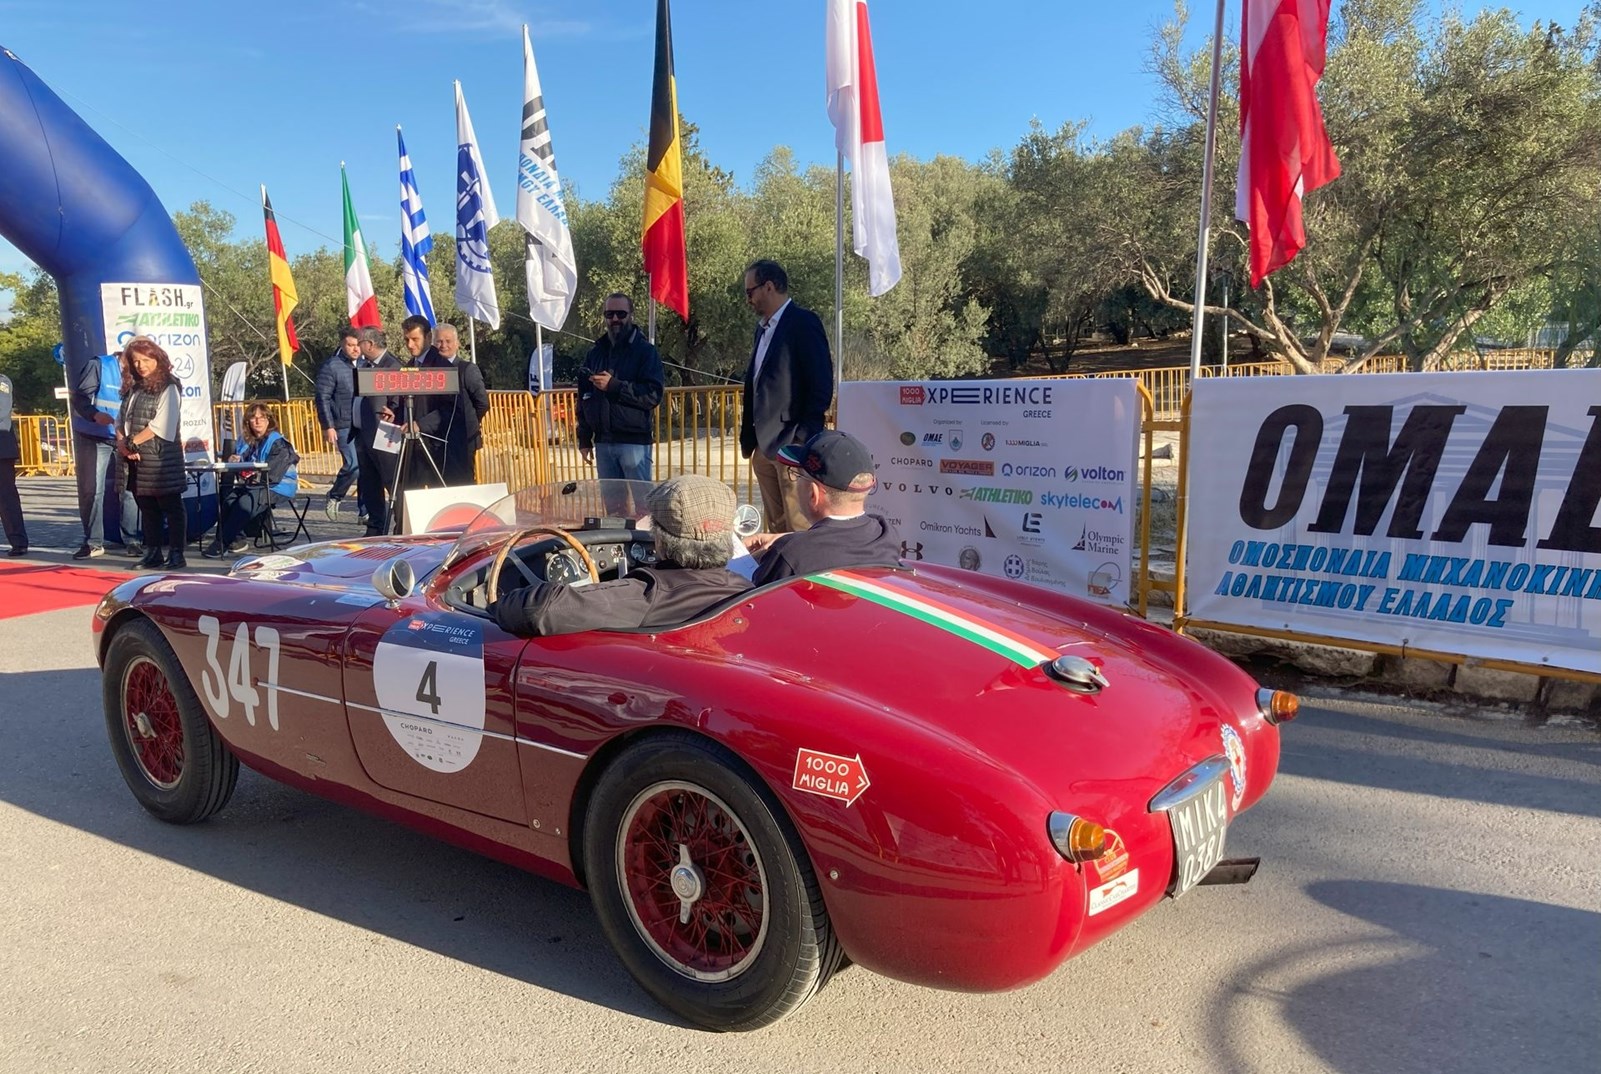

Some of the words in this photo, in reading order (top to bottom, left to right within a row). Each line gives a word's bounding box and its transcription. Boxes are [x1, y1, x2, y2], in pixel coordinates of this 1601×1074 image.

[175, 357, 191, 371] 24
[927, 387, 1053, 405] XPERIENCE
[1022, 410, 1052, 419] GREECE
[890, 457, 934, 468] CHOPARD
[941, 461, 993, 471] VOYAGER
[1015, 465, 1056, 478] orizon
[1081, 466, 1124, 481] volton
[883, 481, 953, 496] VOLVO
[973, 487, 1033, 505] ATHLETIKO
[919, 520, 952, 533] Omikron
[953, 525, 982, 537] Yachts
[1087, 530, 1125, 546] Olympic
[1087, 542, 1119, 555] Marine
[1228, 540, 1392, 580] ΟΜΟΣΠΟΝΔΙΑ
[1214, 571, 1376, 612] ΑΘΛΗΤΙΣΜΟΥ
[1376, 587, 1514, 628] ΕΛΛΑΔΟΣ
[421, 622, 475, 637] XPERIENCE
[448, 636, 469, 645] GREECE
[198, 614, 280, 731] 347
[415, 660, 442, 715] 4
[400, 722, 433, 735] CHOPARD
[806, 756, 850, 777] 1000
[799, 773, 849, 796] MIGLIA
